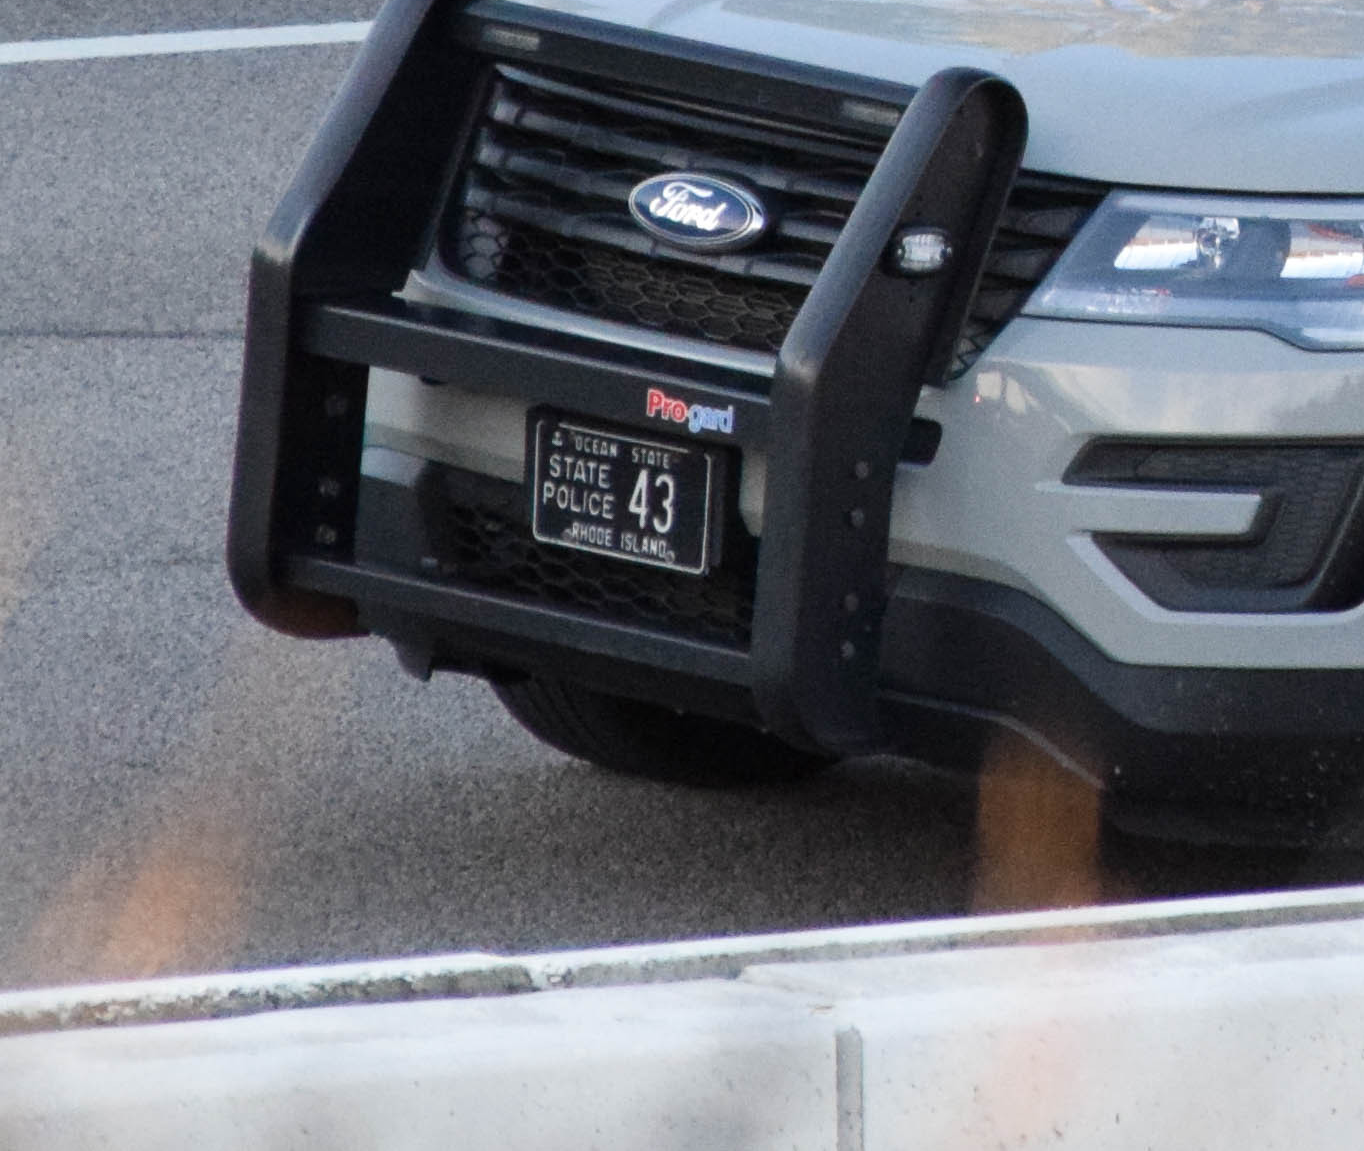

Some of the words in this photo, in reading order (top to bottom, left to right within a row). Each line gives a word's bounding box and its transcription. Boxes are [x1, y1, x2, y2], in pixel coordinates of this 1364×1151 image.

[649, 181, 727, 231] Ford
[549, 454, 611, 489] STATE
[574, 436, 618, 457] OCEAN
[632, 447, 670, 469] STATE
[542, 481, 615, 520] POLICE
[628, 468, 675, 534] 43
[571, 522, 614, 547] RHODE
[620, 533, 667, 559] ISLAND
